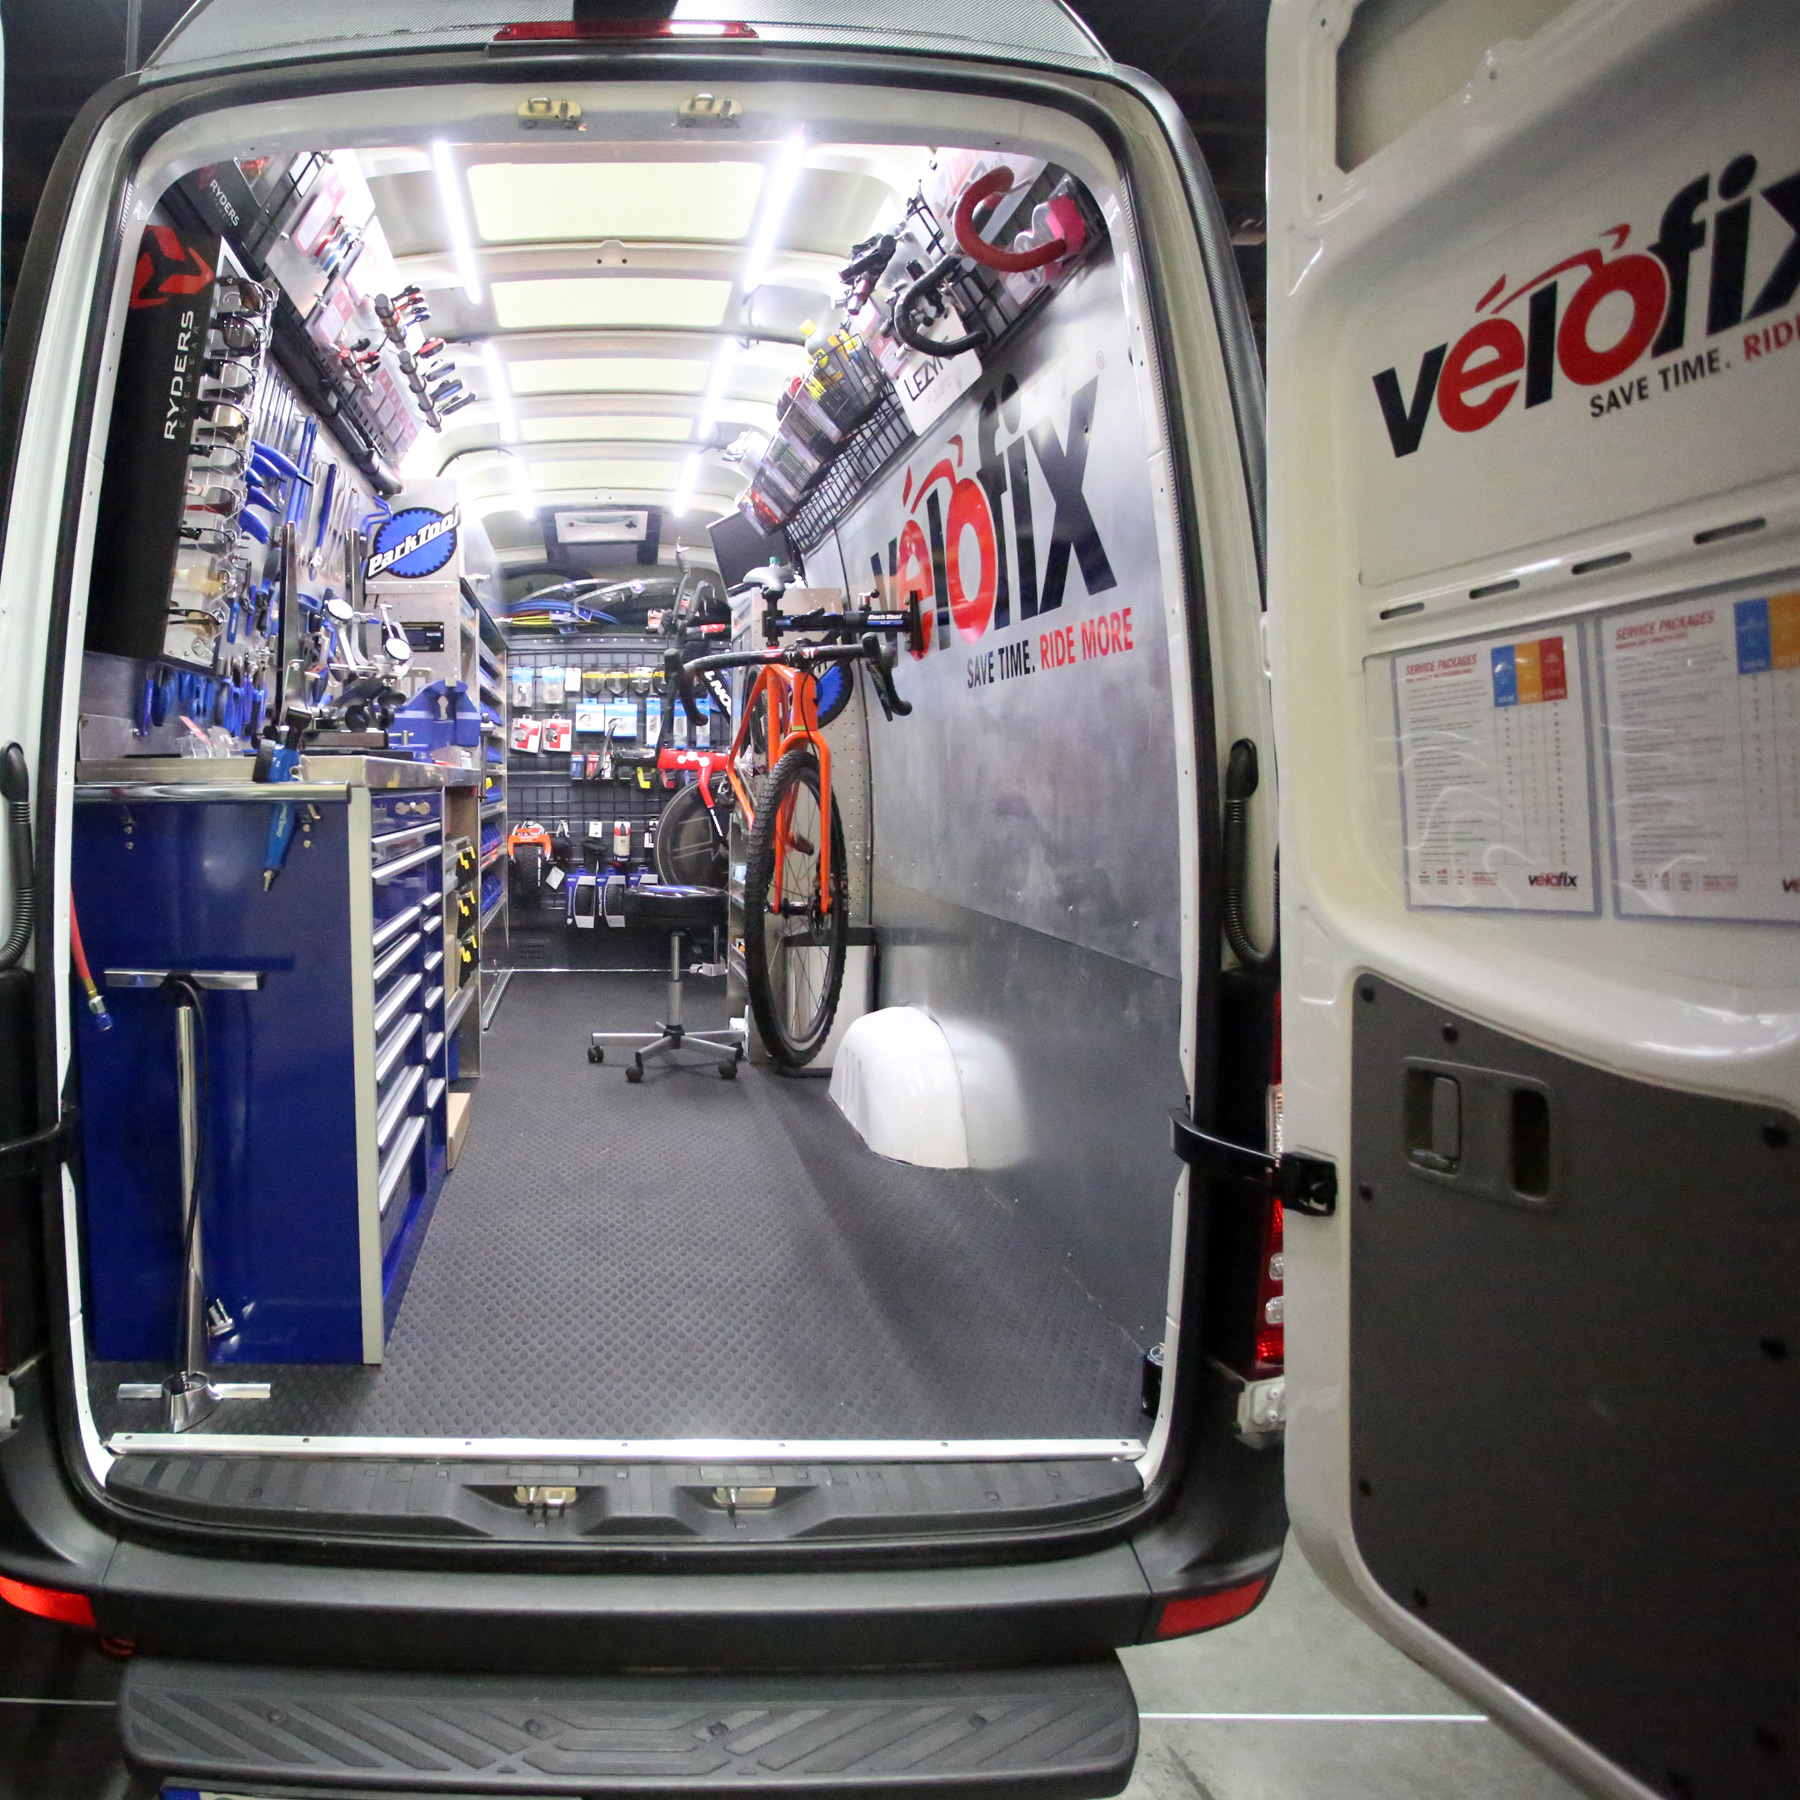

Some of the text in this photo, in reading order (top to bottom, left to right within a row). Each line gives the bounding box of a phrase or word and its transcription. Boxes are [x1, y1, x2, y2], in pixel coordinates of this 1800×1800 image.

[210, 179, 240, 227] RYDERS
[164, 310, 194, 440] RYDERS
[1590, 376, 1649, 418] SAVE
[1658, 348, 1731, 392] TIME.
[967, 607, 1134, 689] SAVE TIME. RIDE MORE
[1528, 871, 1578, 888] velofix
